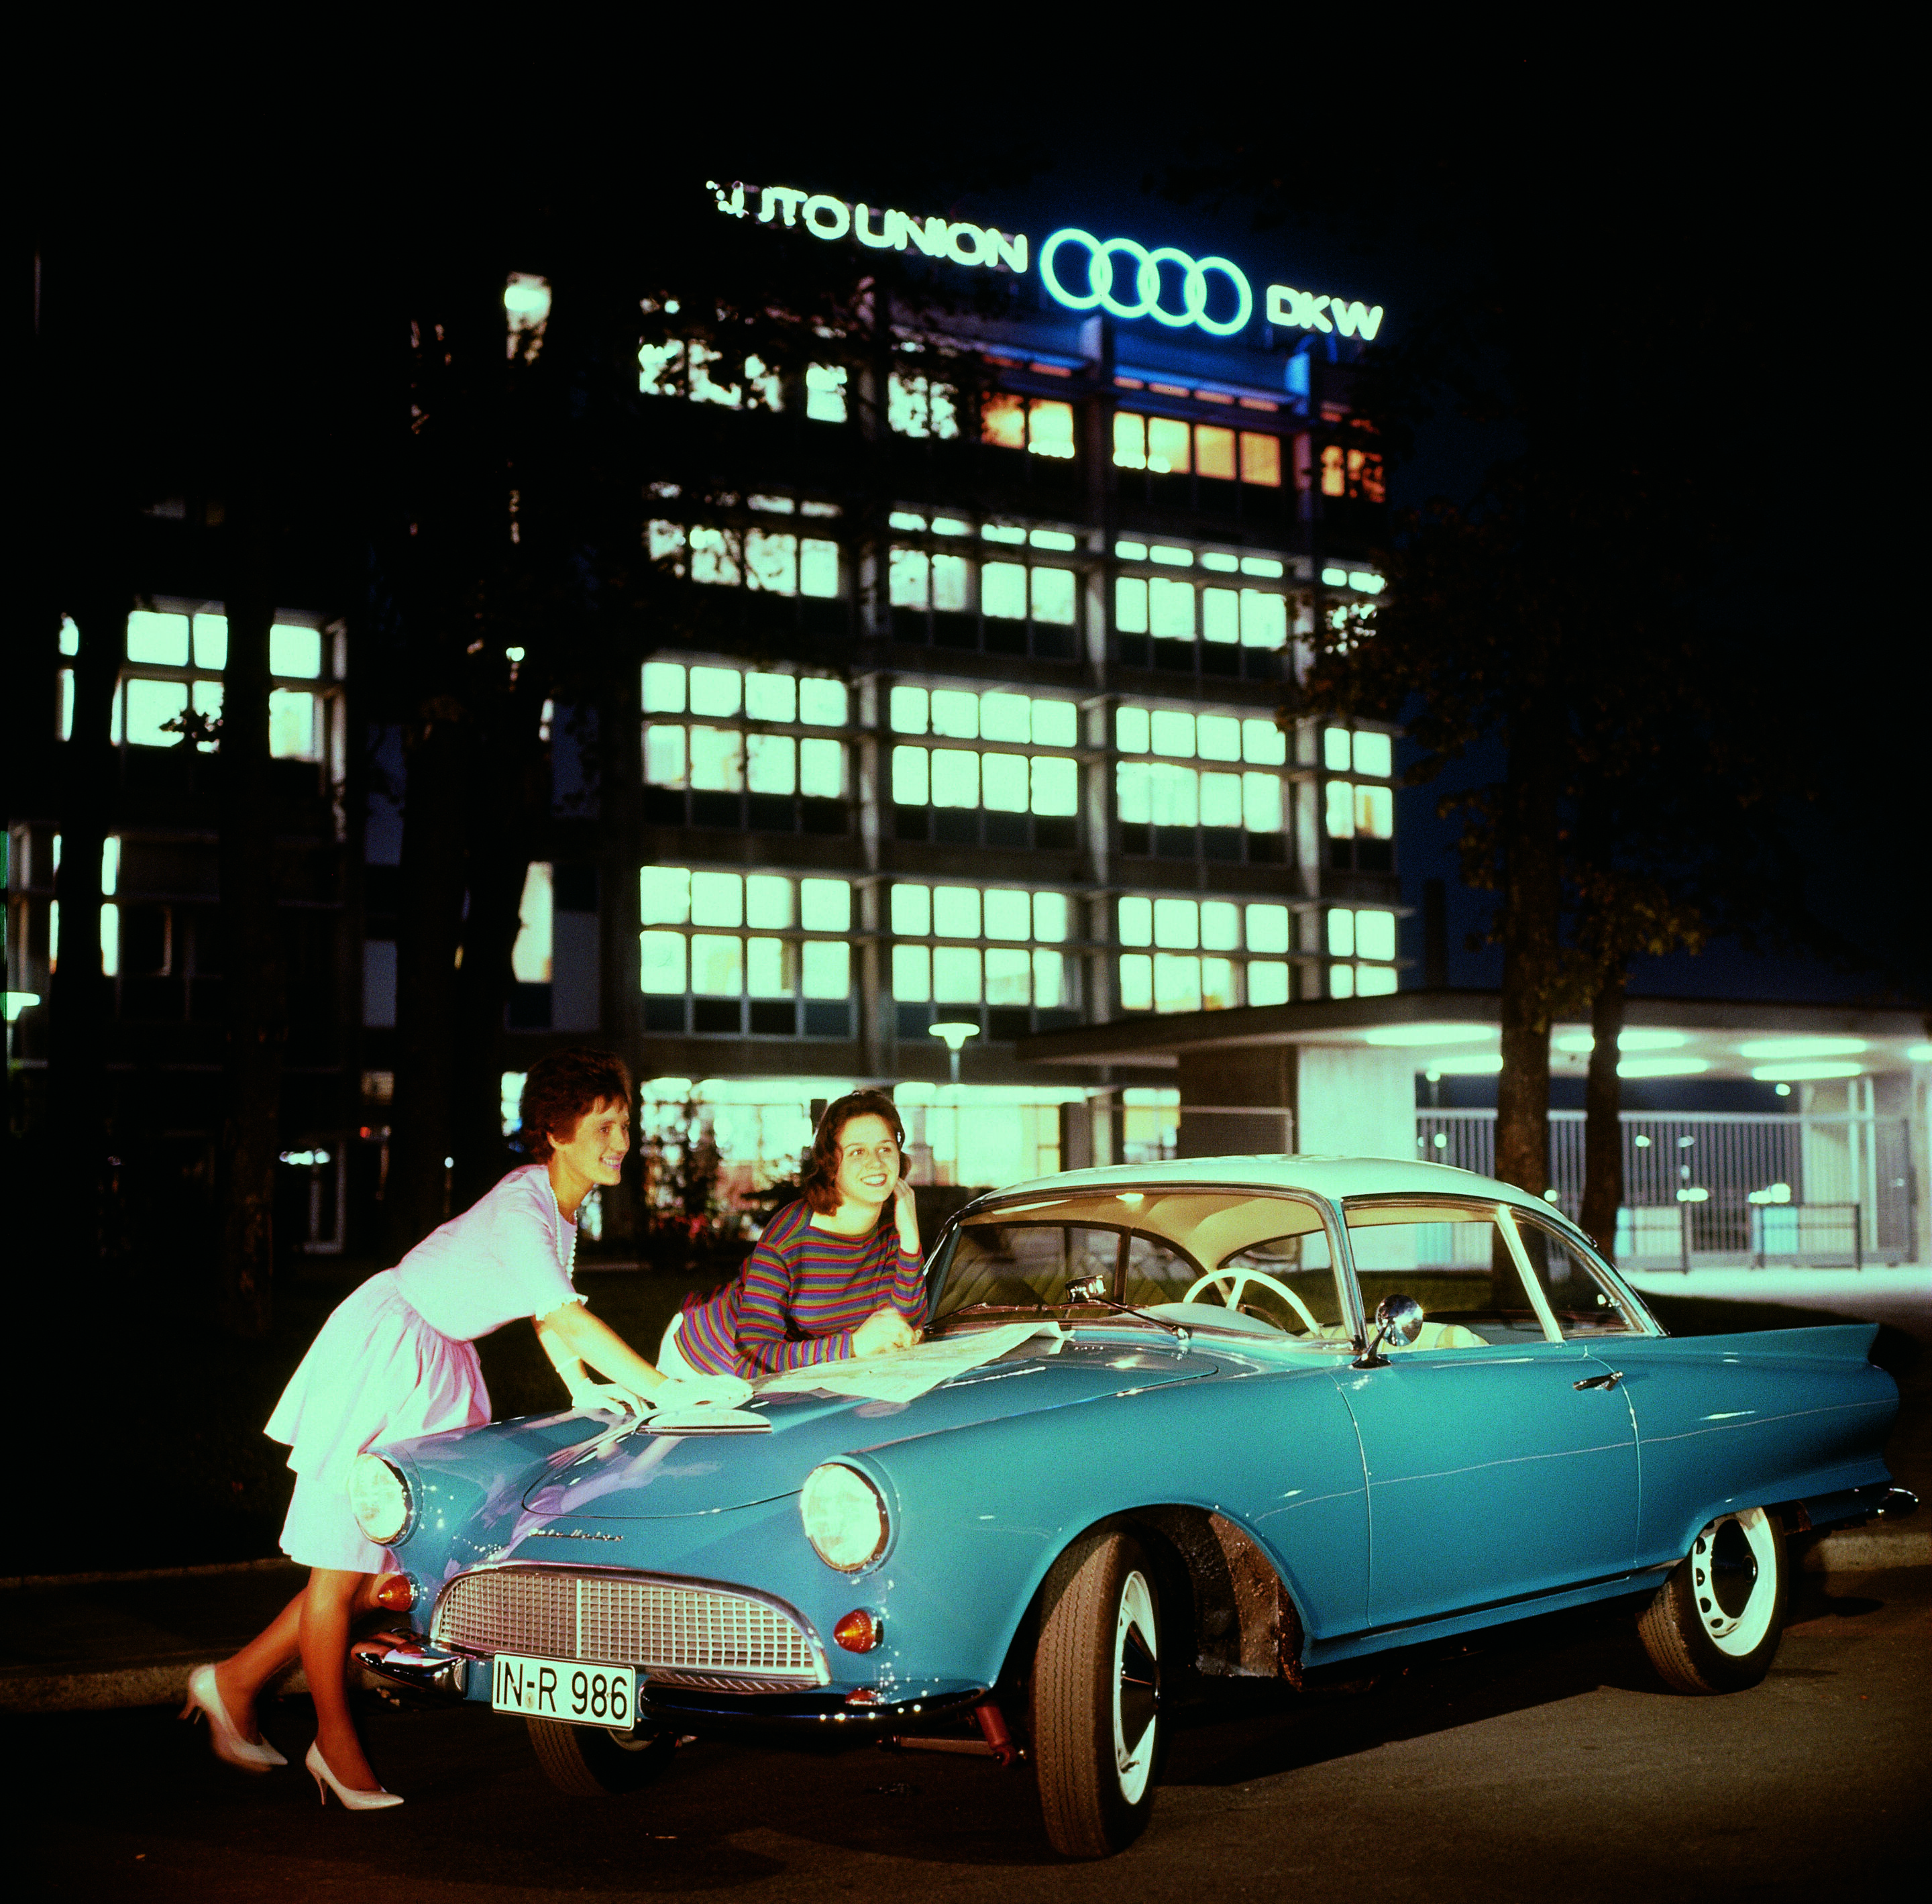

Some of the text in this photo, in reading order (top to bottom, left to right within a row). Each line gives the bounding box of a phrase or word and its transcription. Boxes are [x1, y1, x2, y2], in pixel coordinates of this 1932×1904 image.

[1267, 284, 1384, 341] DKW
[496, 1661, 627, 1720] IN-R 986
